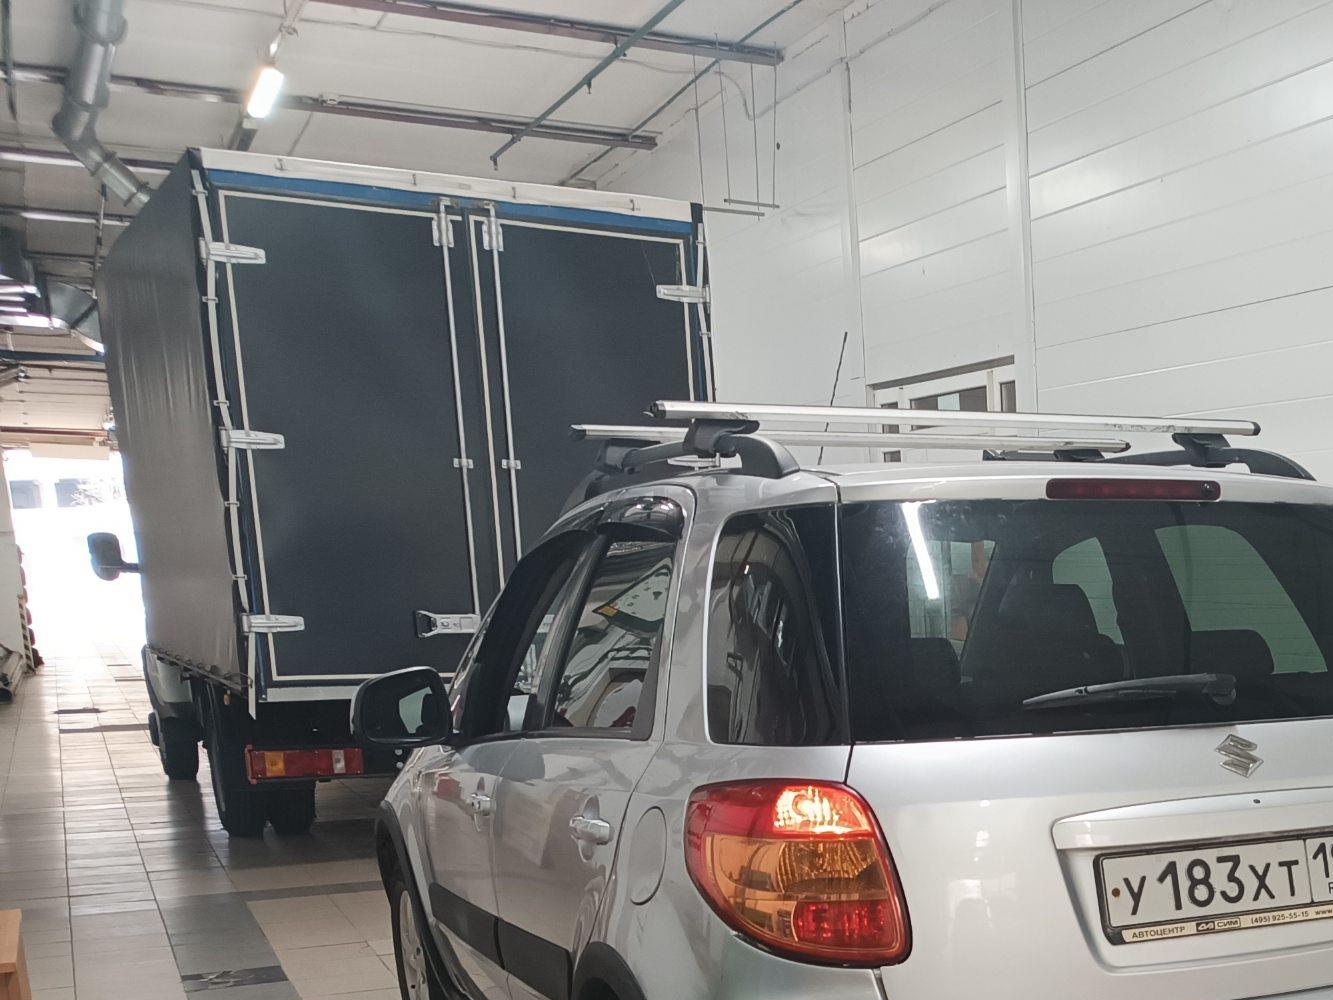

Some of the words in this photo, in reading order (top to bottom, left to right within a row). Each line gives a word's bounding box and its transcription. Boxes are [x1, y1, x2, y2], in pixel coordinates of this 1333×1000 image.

[1131, 926, 1186, 940] АВТОЦЕНТР
[1216, 919, 1239, 929] СИМ
[1250, 915, 1271, 925] (495)
[1271, 910, 1310, 922] 925-55-15
